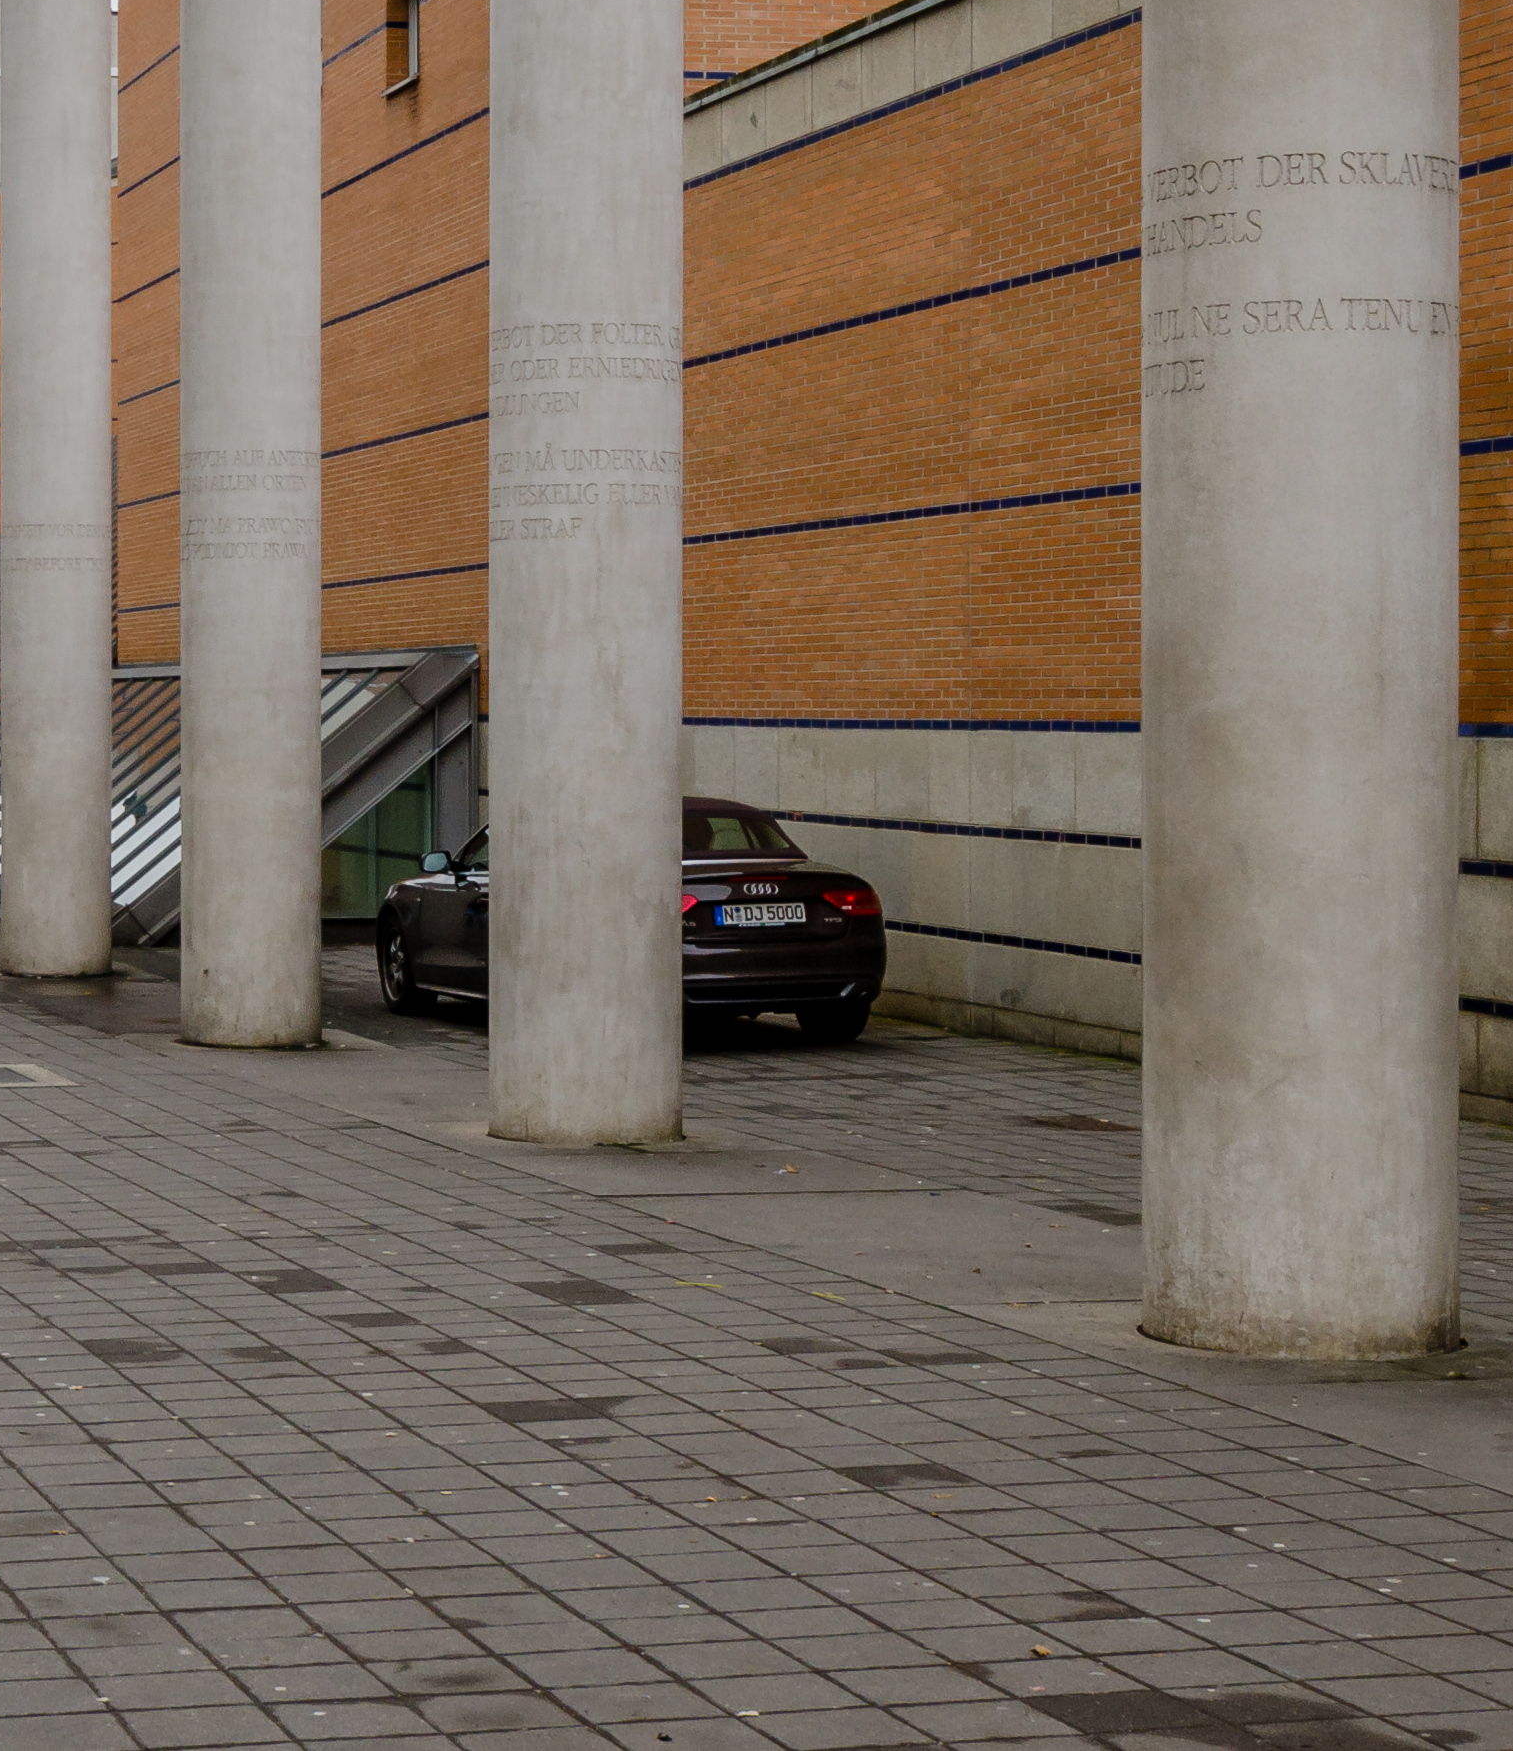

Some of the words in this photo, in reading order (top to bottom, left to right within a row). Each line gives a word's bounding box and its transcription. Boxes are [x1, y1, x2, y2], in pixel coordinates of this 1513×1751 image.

[1255, 152, 1330, 189] DER
[1145, 209, 1264, 257] HANDELS
[1191, 303, 1232, 338] NE
[1242, 298, 1334, 335] SERA
[1340, 298, 1424, 333] TENU
[541, 323, 583, 346] DER
[591, 322, 665, 346] FOLTER
[510, 358, 561, 383] ODER
[525, 442, 557, 472] MÅ
[606, 483, 662, 505] ELLER
[521, 516, 583, 540] STRAF
[724, 909, 734, 923] N
[744, 906, 764, 922] DJ
[767, 905, 804, 921] 5000
